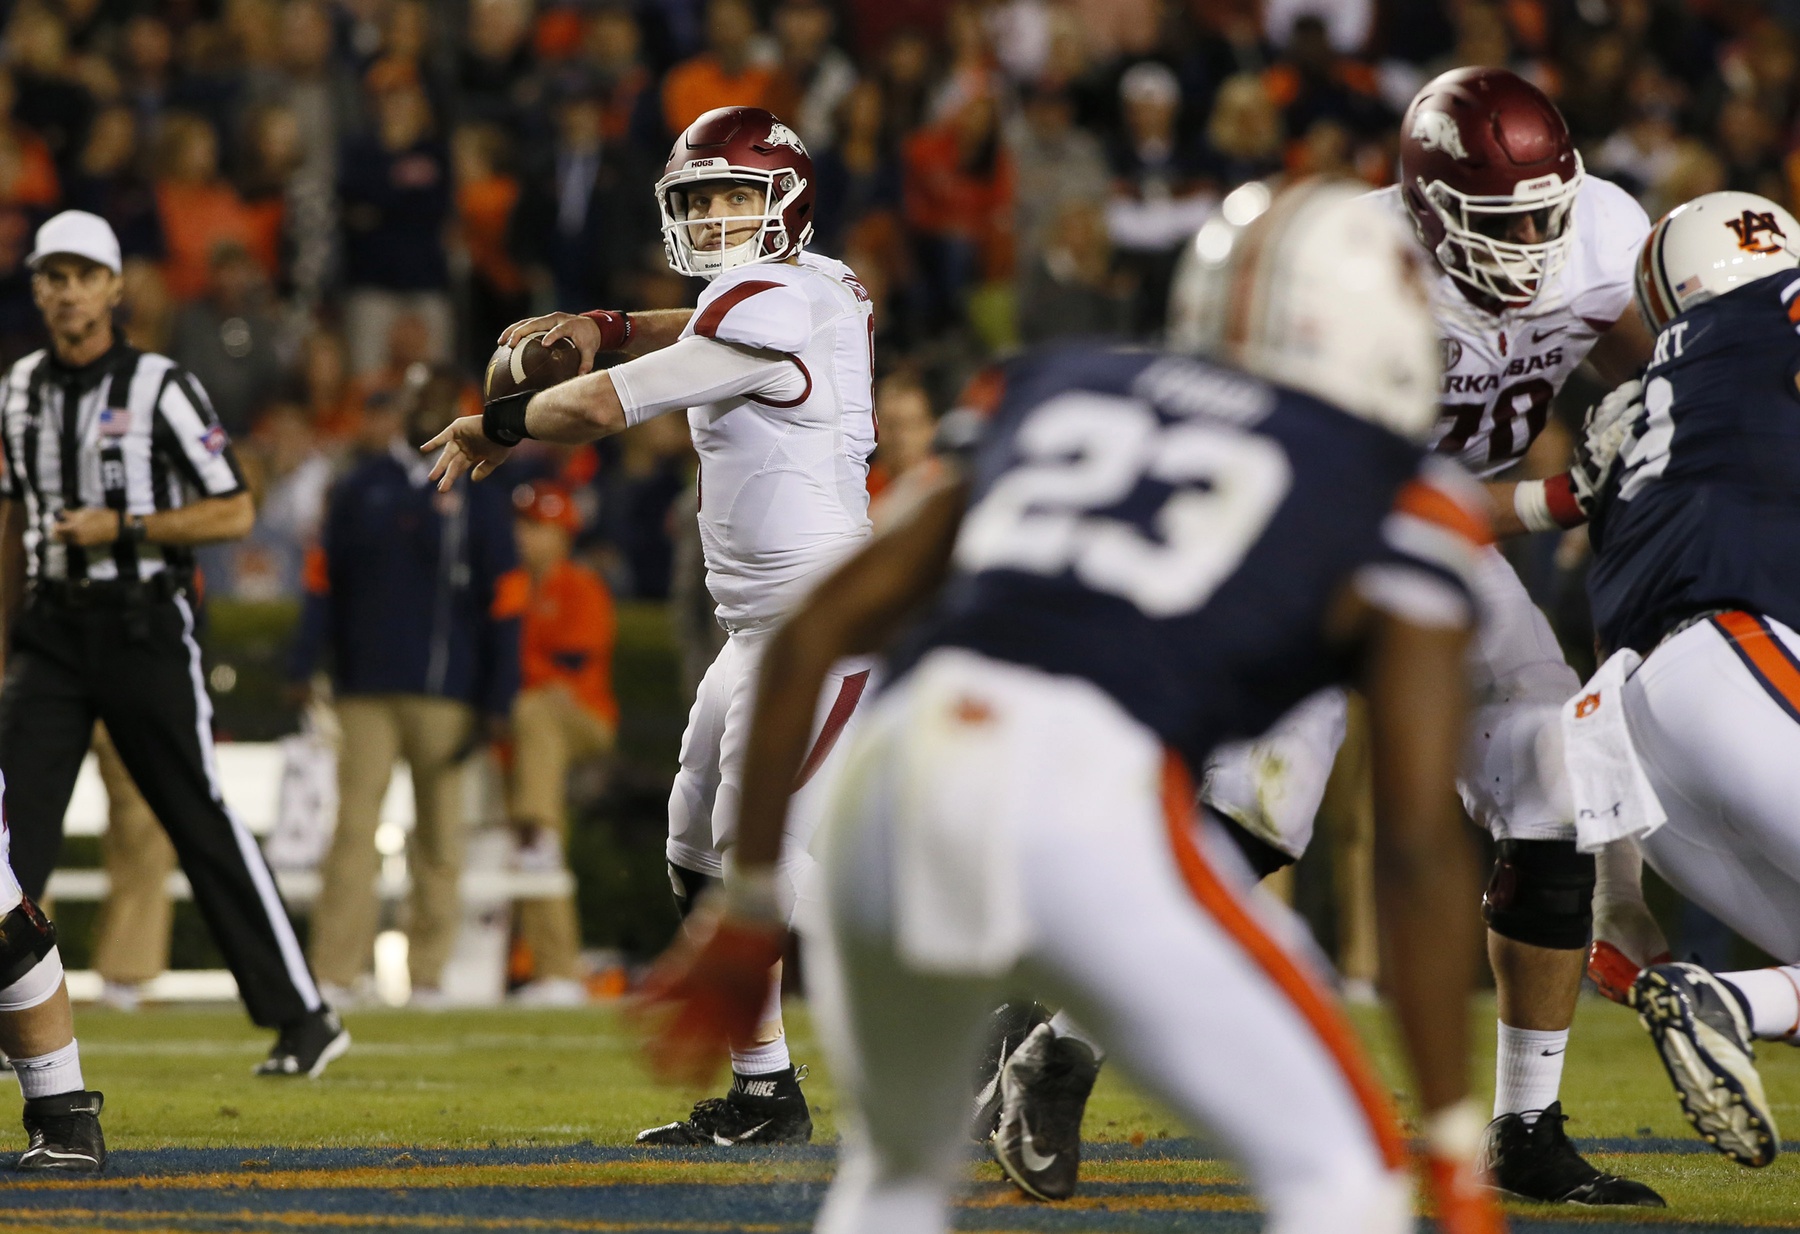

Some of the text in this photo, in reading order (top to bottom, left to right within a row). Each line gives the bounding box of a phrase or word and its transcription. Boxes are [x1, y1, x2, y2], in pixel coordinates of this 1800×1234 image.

[691, 160, 714, 168] HOGS
[1647, 320, 1689, 369] RT
[1444, 347, 1563, 394] RKASAS
[1435, 377, 1554, 462] 70
[953, 388, 1294, 619] 23
[743, 1079, 778, 1097] NIKE
